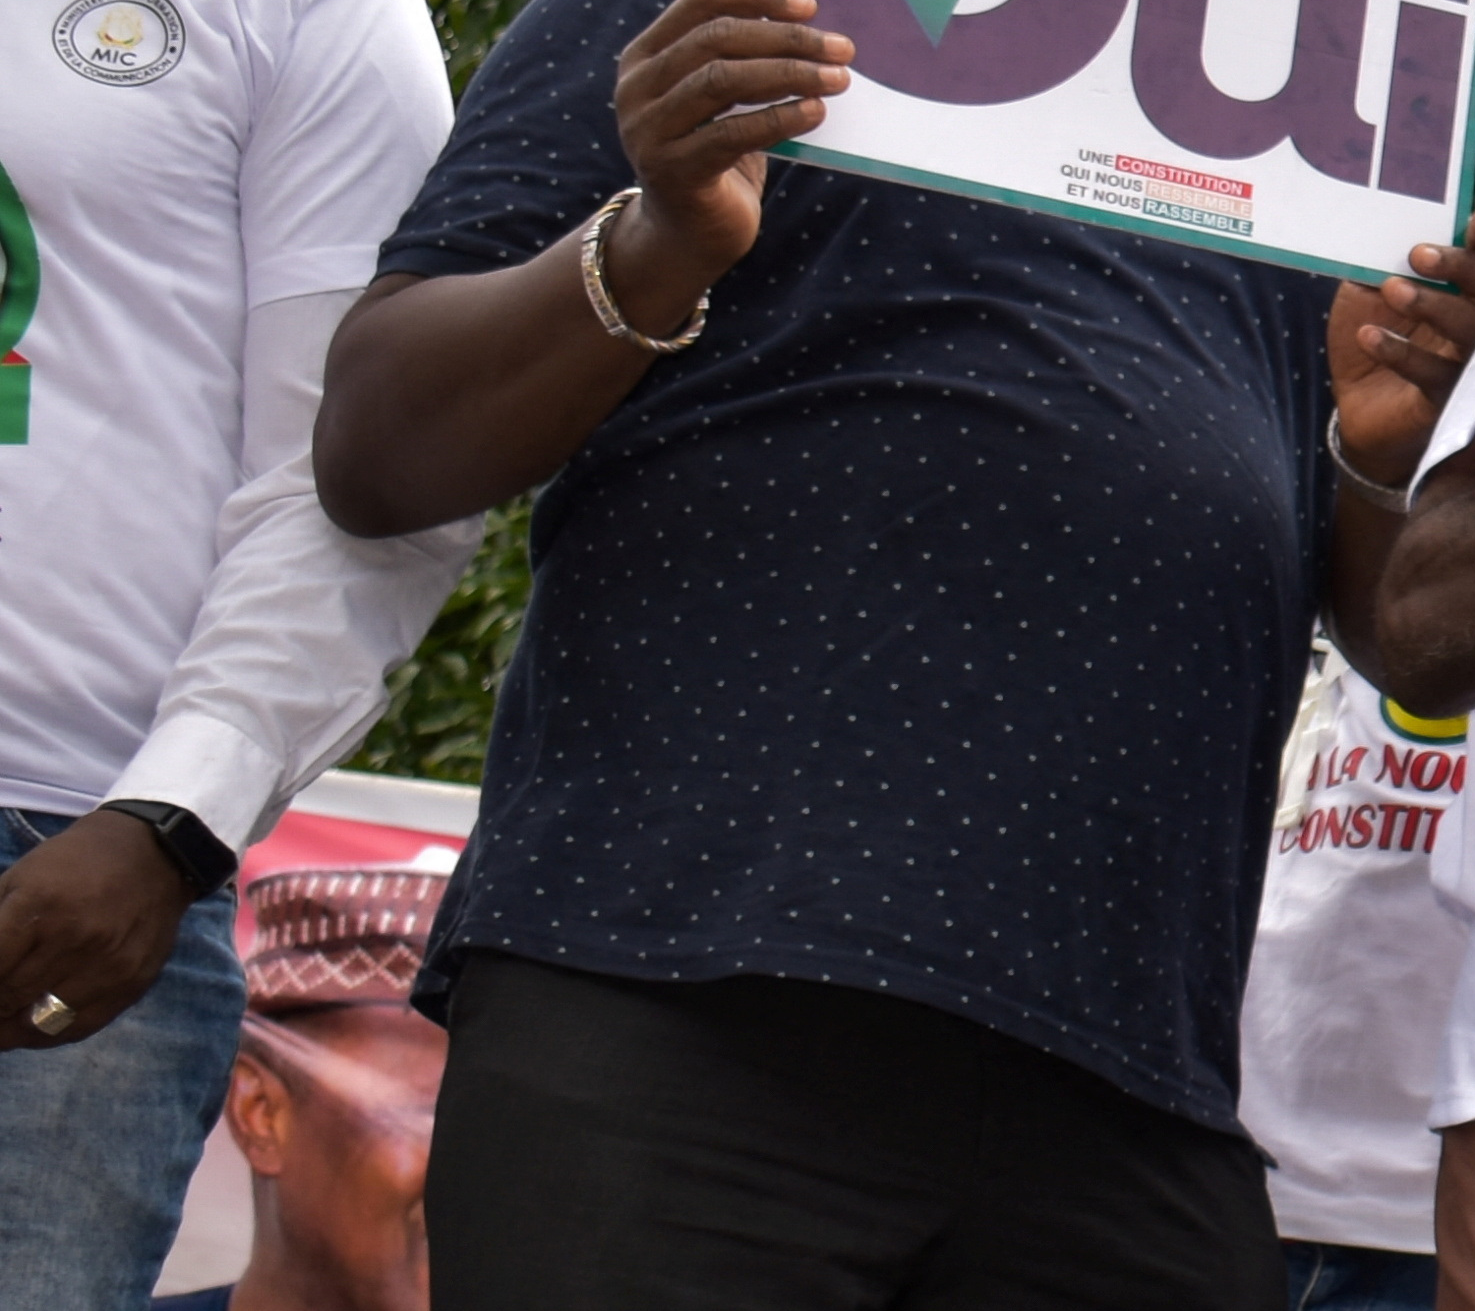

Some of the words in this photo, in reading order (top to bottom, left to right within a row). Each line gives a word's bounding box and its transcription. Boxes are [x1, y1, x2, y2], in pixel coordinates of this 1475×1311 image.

[91, 47, 138, 67] MIC
[1060, 164, 1091, 181] QUI
[1095, 172, 1144, 193] NOUS
[1147, 182, 1252, 216] RESSEMBLE
[1078, 148, 1114, 167] UNE
[1117, 157, 1244, 197] CONSTITUTION
[1066, 183, 1088, 197] ET
[1093, 190, 1142, 210] NOUS
[1144, 200, 1252, 235] RASSEMBLE
